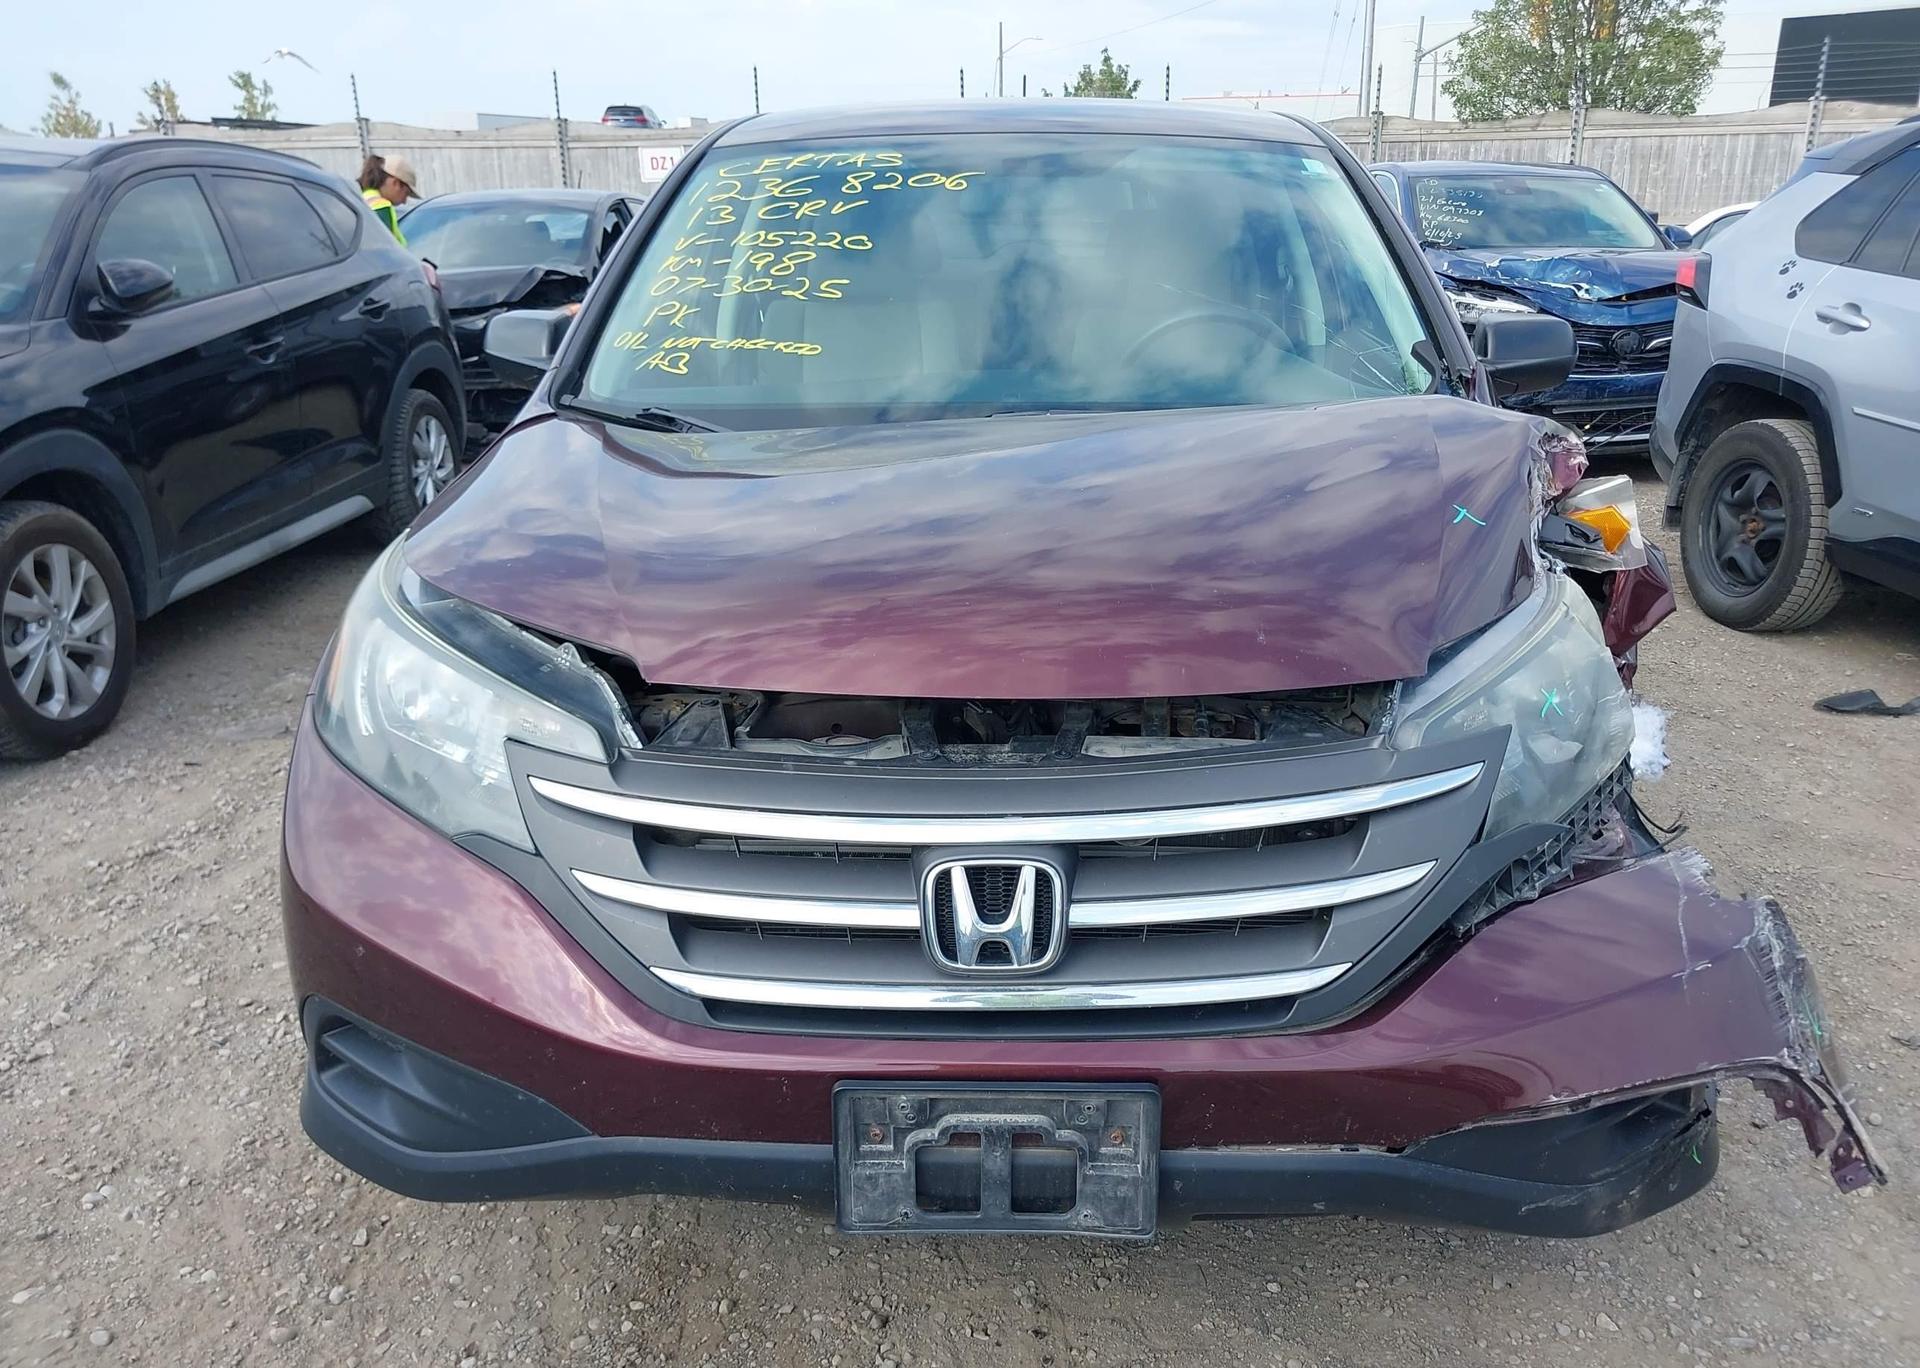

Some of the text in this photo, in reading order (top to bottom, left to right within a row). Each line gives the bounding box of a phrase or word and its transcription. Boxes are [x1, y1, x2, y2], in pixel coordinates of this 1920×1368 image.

[841, 171, 986, 194] 8206
[687, 199, 870, 230] 13 CRV
[614, 332, 649, 351] OIL
